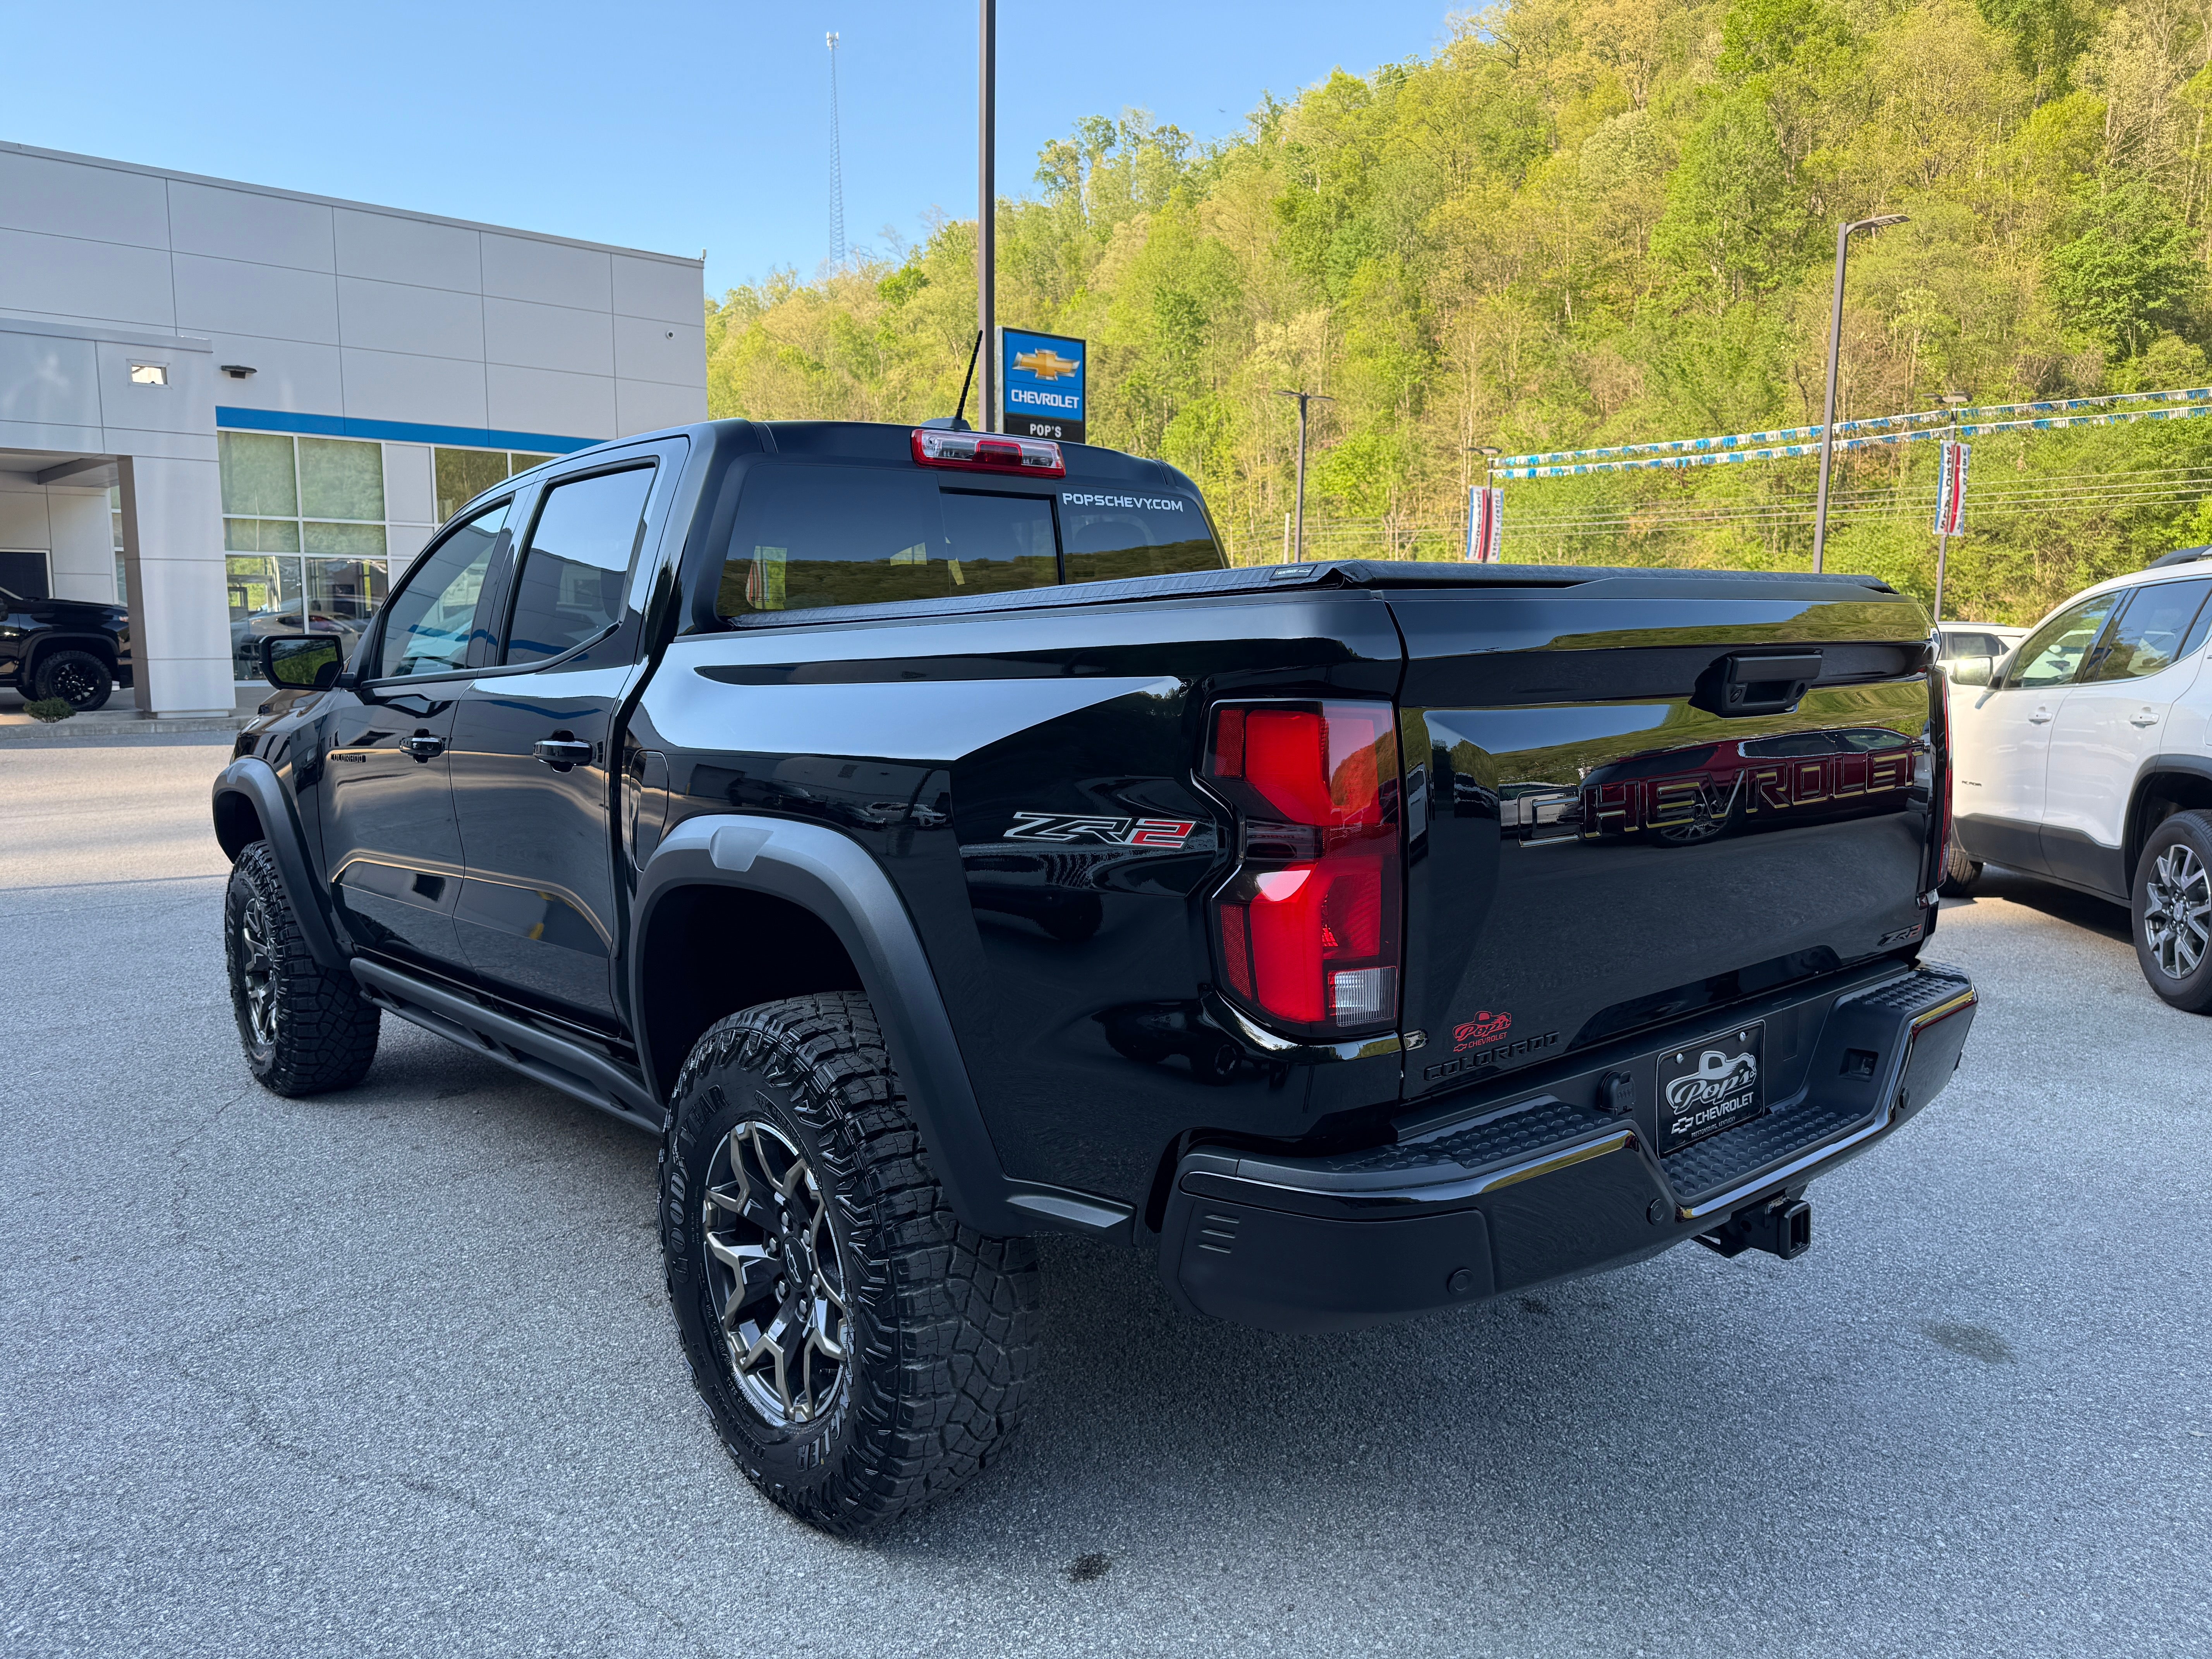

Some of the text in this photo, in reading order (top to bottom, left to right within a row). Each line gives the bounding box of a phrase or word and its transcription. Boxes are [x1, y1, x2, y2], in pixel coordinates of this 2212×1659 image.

[1011, 388, 1080, 409] CHEVROLET
[1030, 423, 1062, 438] POP'S
[1062, 493, 1183, 512] POPSCHEVY.COM
[1517, 746, 1924, 848] CHEVROLET
[1003, 811, 1197, 849] ZR2
[1878, 924, 1922, 946] ZR2
[1468, 1031, 1507, 1048] CHEVROLET
[1424, 1031, 1560, 1080] COLORADO
[1674, 1068, 1757, 1108] Pop's
[1695, 1092, 1753, 1125] CHEVROLET
